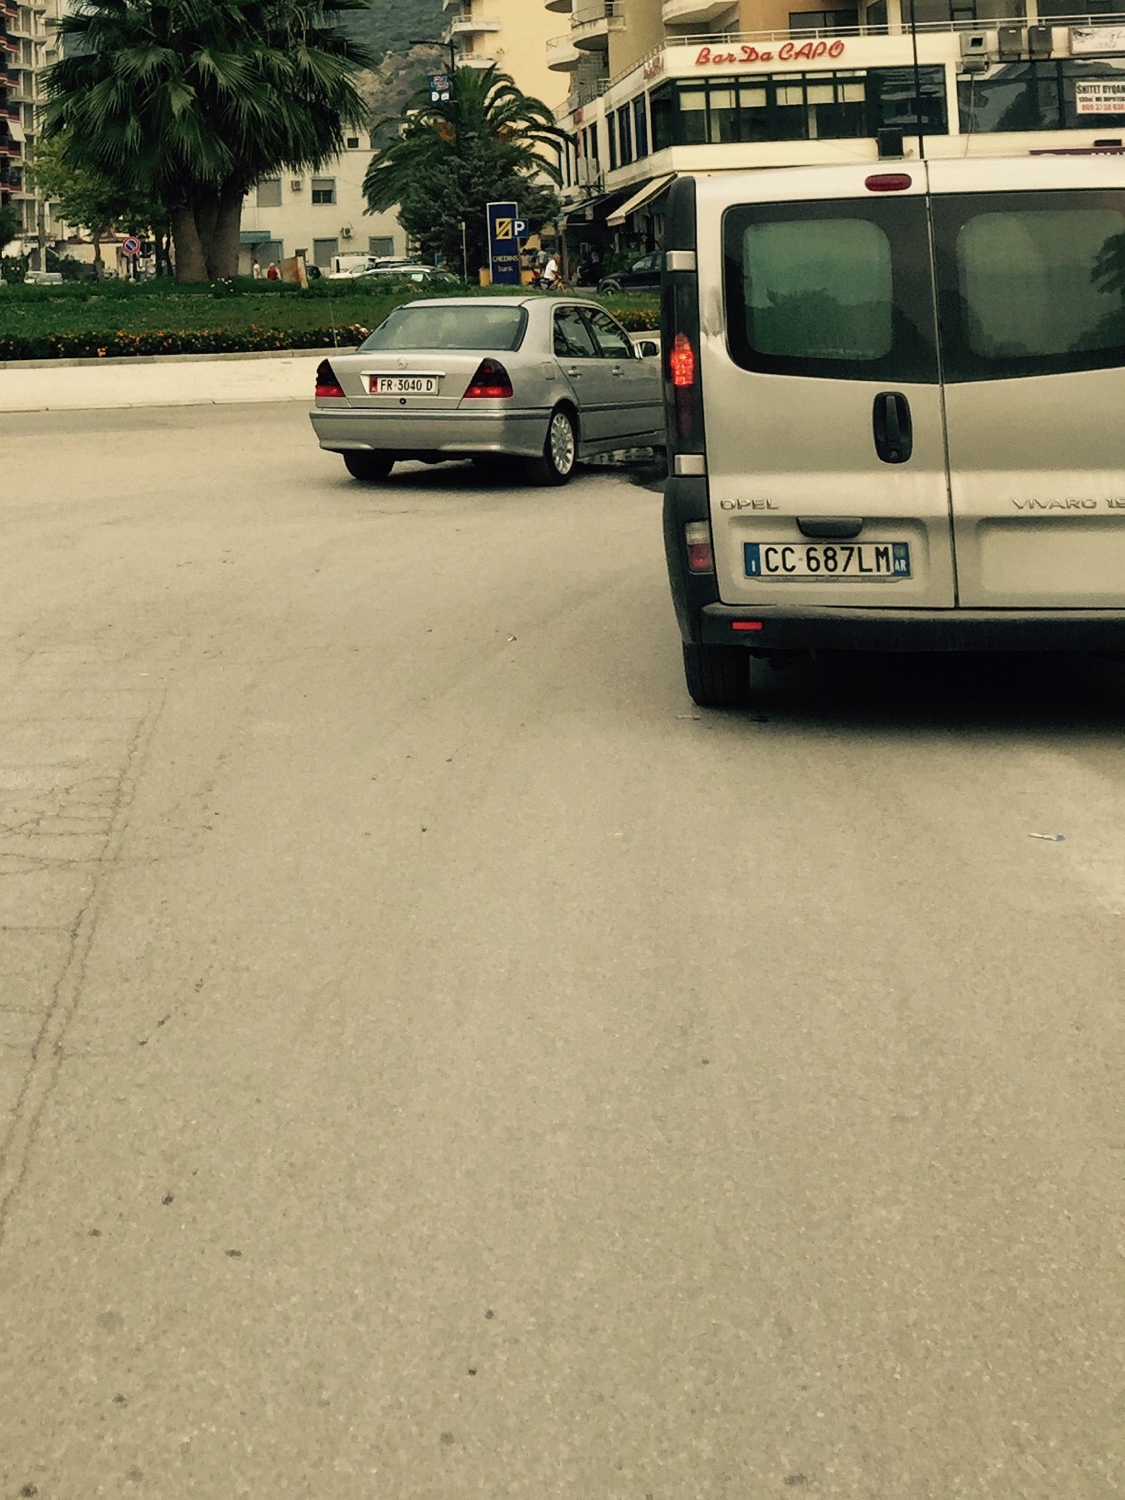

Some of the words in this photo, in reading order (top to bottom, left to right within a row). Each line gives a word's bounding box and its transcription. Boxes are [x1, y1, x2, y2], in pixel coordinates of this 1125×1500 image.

[695, 47, 736, 66] Bar
[738, 45, 774, 63] Da
[778, 40, 845, 61] CAPO
[514, 220, 525, 236] P
[380, 379, 393, 391] FR
[720, 498, 780, 511] OPEL
[1011, 498, 1097, 510] VIVARO
[765, 546, 796, 573] CC
[806, 546, 891, 573] 687LM
[894, 559, 907, 572] AR
